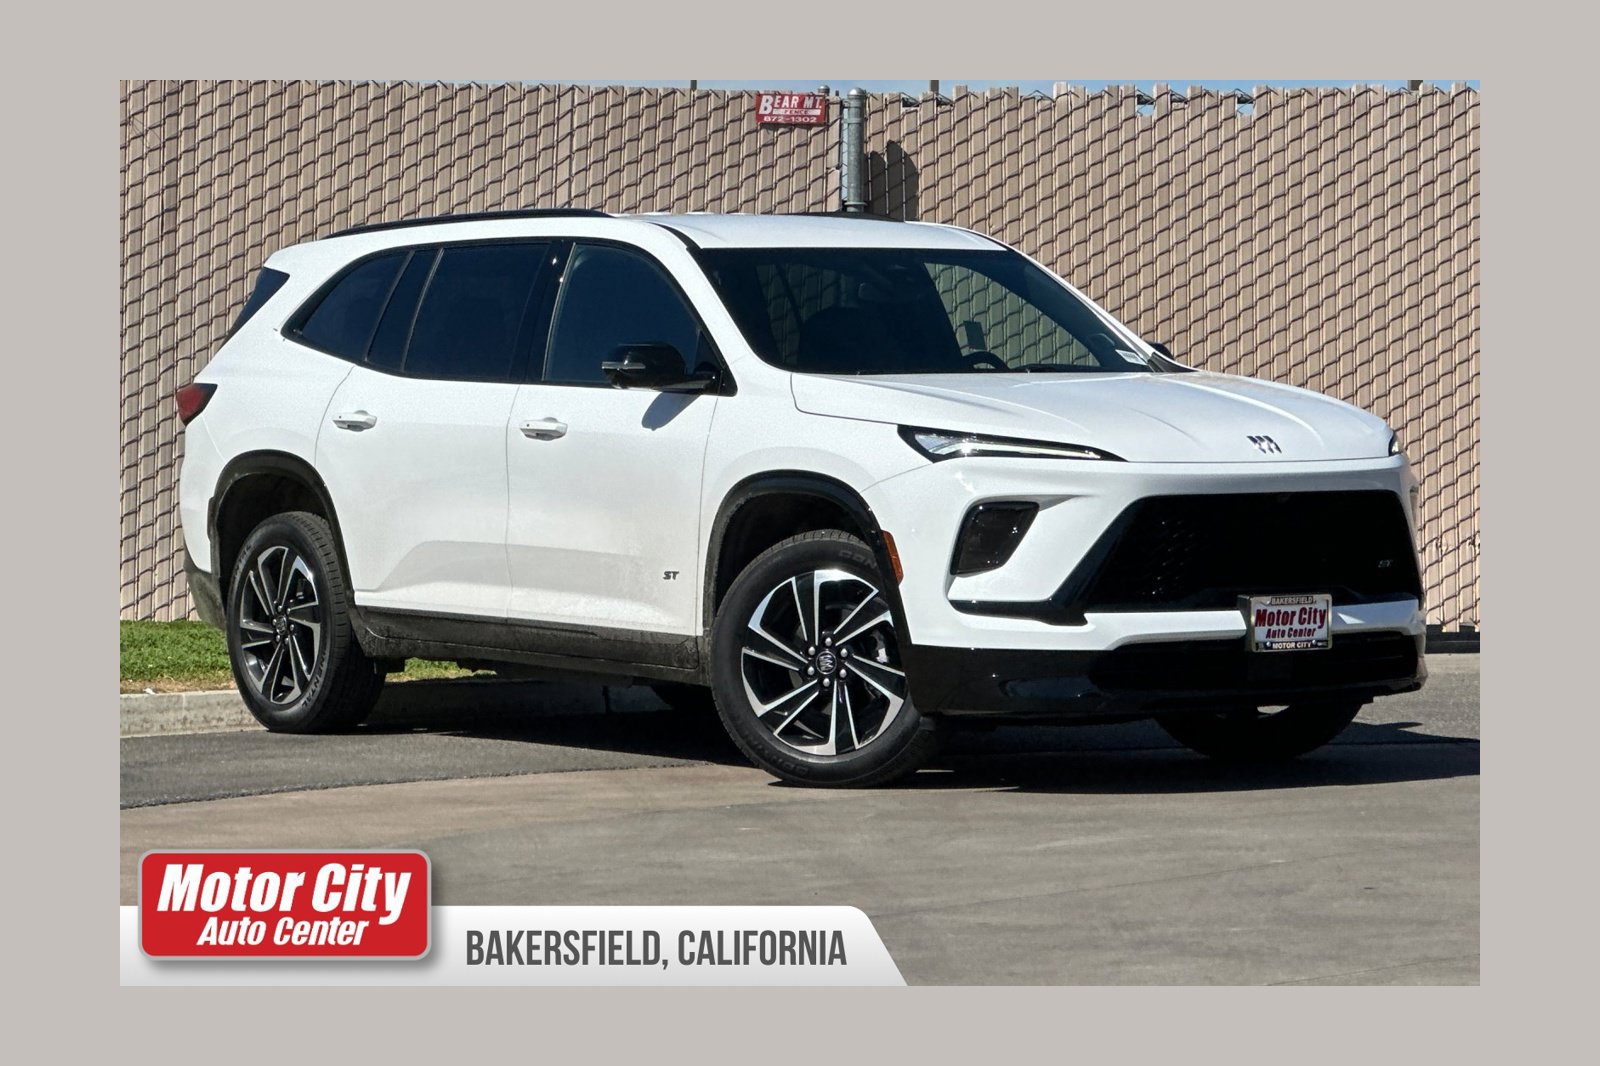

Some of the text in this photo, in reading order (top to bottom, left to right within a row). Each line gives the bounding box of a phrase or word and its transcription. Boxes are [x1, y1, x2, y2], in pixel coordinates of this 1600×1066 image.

[759, 95, 822, 115] BEAR MT.
[663, 571, 680, 580] ST
[1271, 596, 1312, 604] BAKERSFIELD
[1255, 607, 1326, 630] Motor City
[1266, 628, 1316, 639] Auto Center
[1272, 640, 1311, 649] MOTOR CITY
